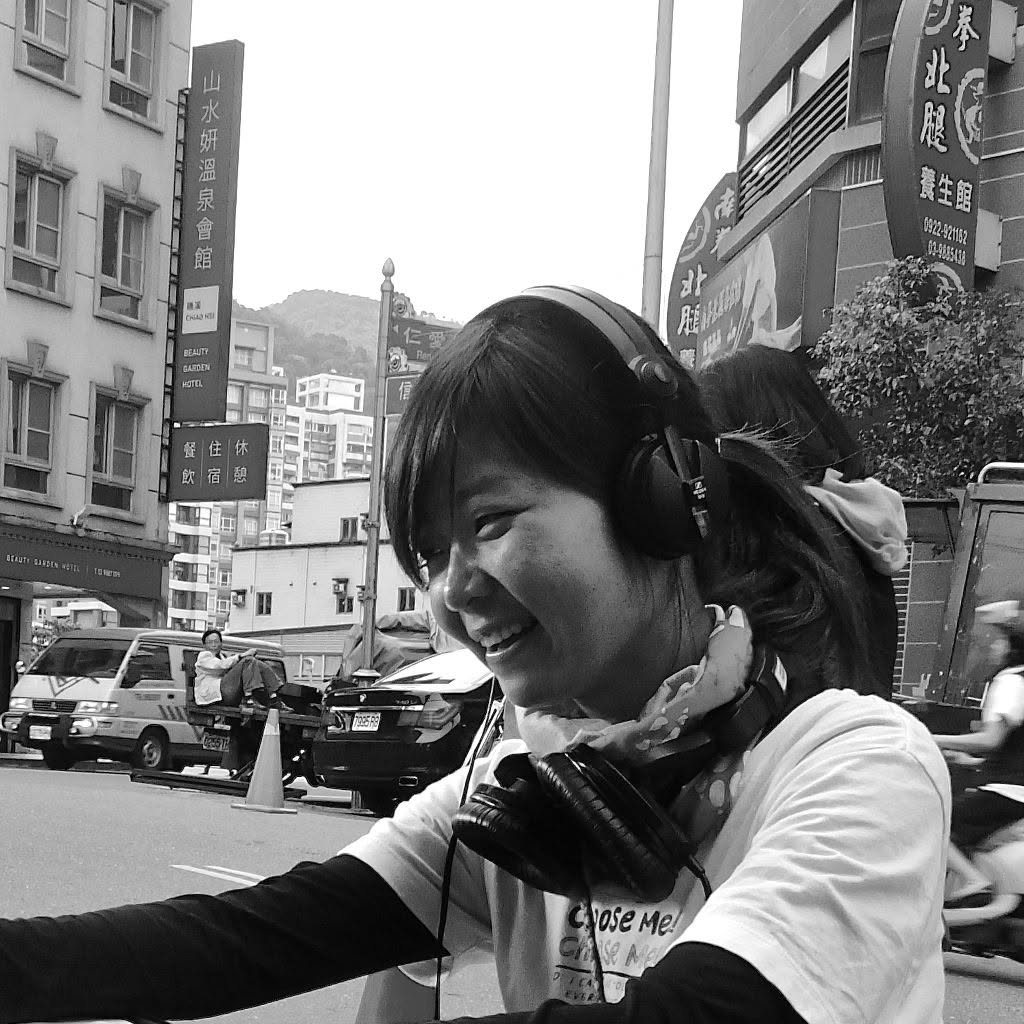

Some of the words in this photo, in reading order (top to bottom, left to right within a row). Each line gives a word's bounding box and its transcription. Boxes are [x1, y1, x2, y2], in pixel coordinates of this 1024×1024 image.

[919, 46, 952, 154] 北腿
[193, 69, 222, 271] 山水妍溫泉會館
[919, 165, 974, 214] 養生館
[182, 364, 211, 373] GARDEN
[183, 347, 209, 357] BEAUTY
[182, 380, 204, 389] HOTEL
[182, 440, 196, 486] 餐飲
[207, 439, 222, 486] 住宿
[233, 438, 249, 485] 休憩
[6, 554, 30, 564] BEAUTY
[33, 558, 59, 569] GARDEN
